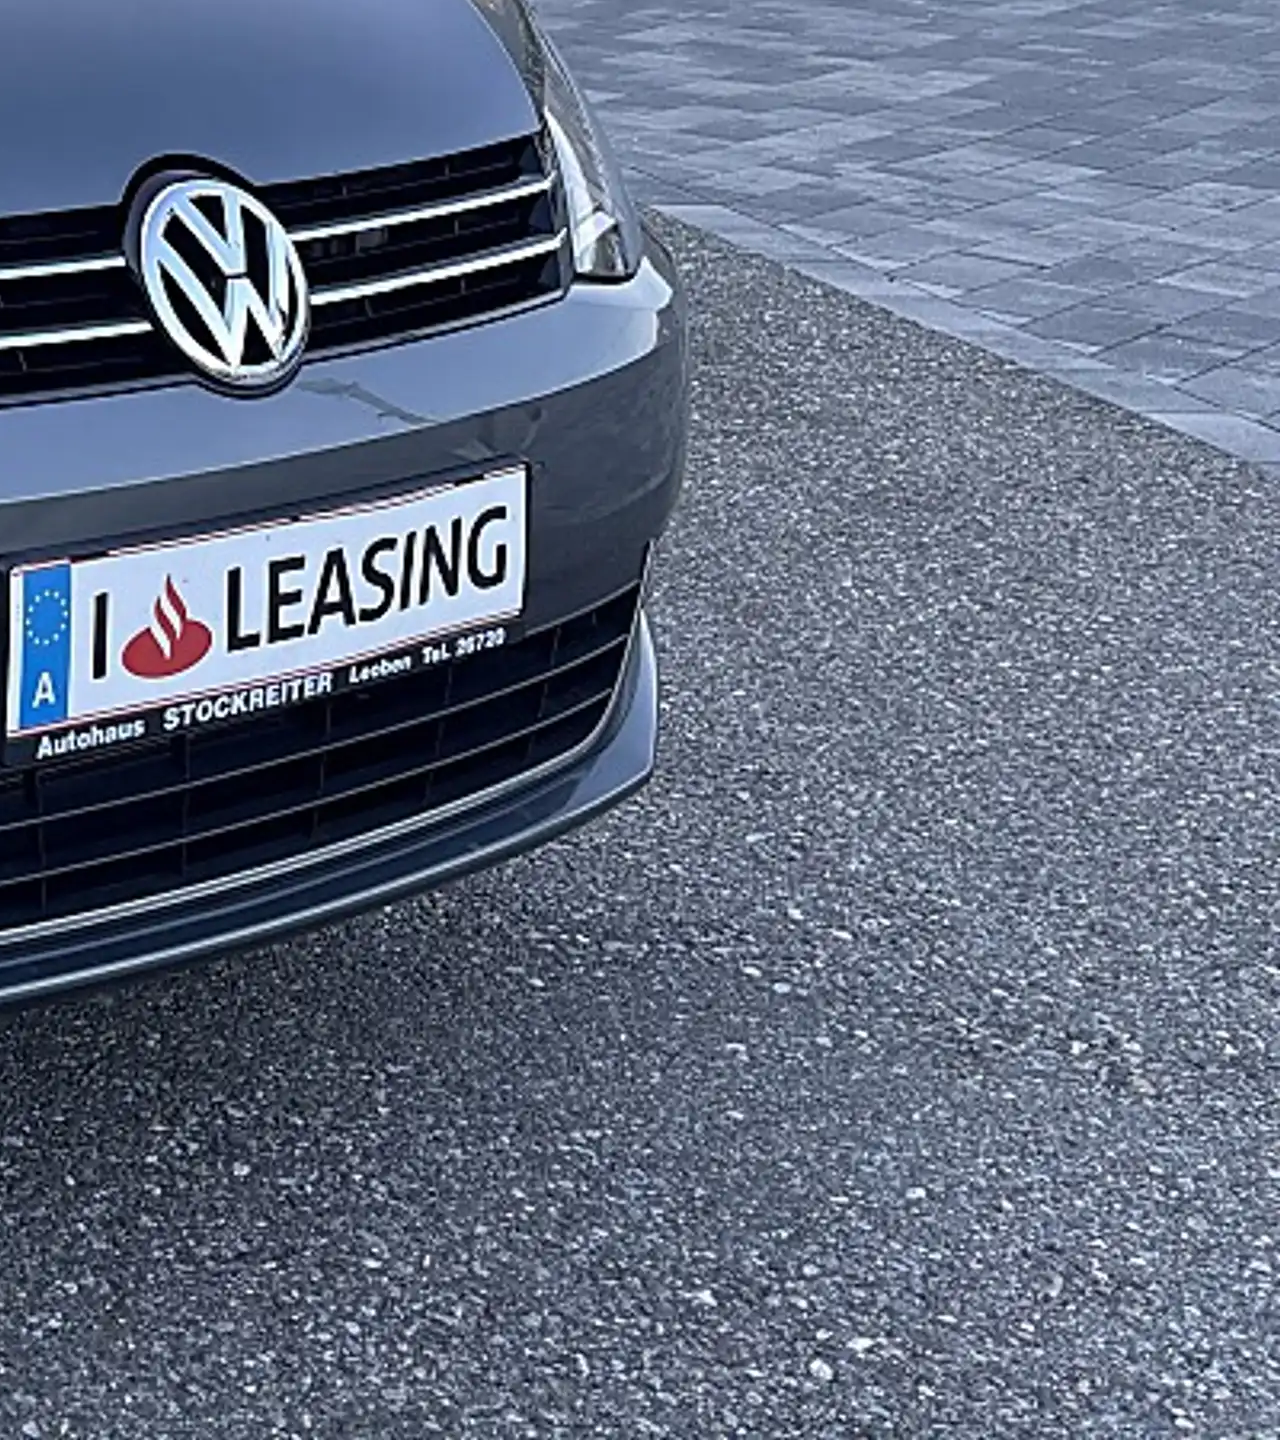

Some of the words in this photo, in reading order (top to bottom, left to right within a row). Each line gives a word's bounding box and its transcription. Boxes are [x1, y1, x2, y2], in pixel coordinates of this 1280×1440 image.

[92, 591, 109, 680] I
[226, 505, 508, 652] LEASING
[32, 671, 56, 709] A
[36, 718, 146, 760] Autohaus
[162, 671, 333, 731] STOCKREITER
